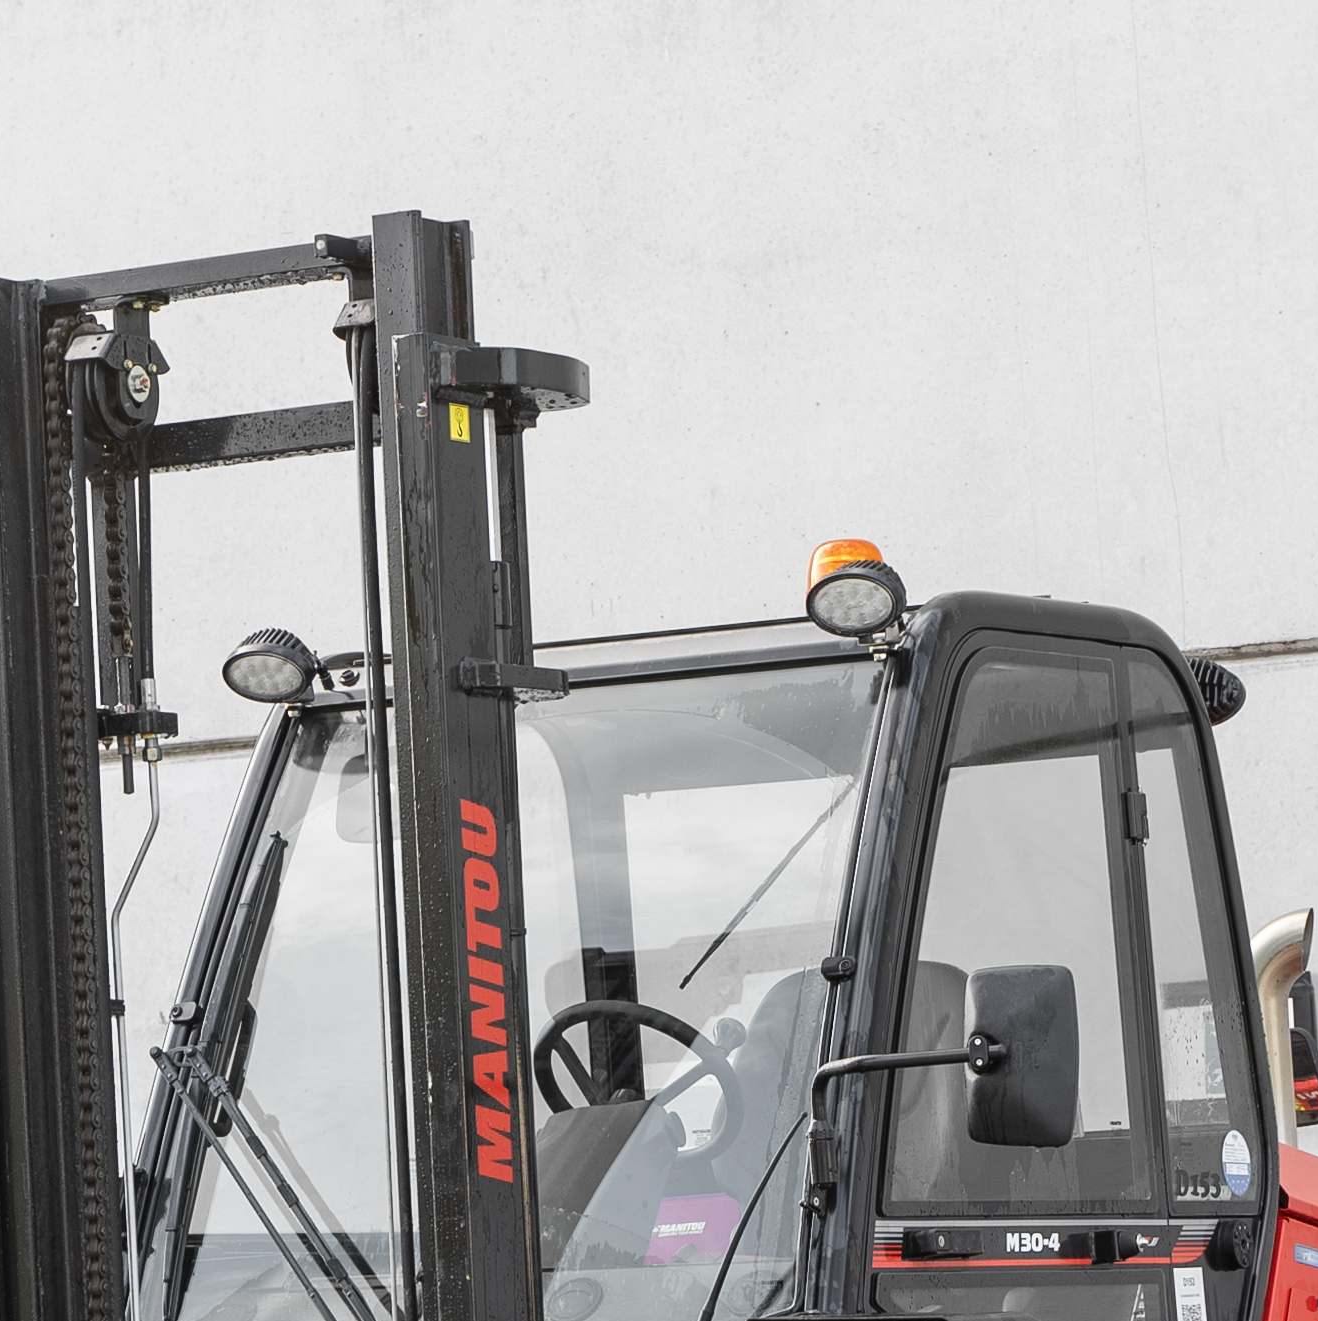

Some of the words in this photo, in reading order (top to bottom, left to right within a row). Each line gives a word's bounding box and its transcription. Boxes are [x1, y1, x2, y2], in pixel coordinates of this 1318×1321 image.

[460, 799, 514, 1184] MANITOU
[1175, 1169, 1222, 1198] D153
[659, 1221, 707, 1232] MANITOU
[1006, 1232, 1061, 1253] M30-4
